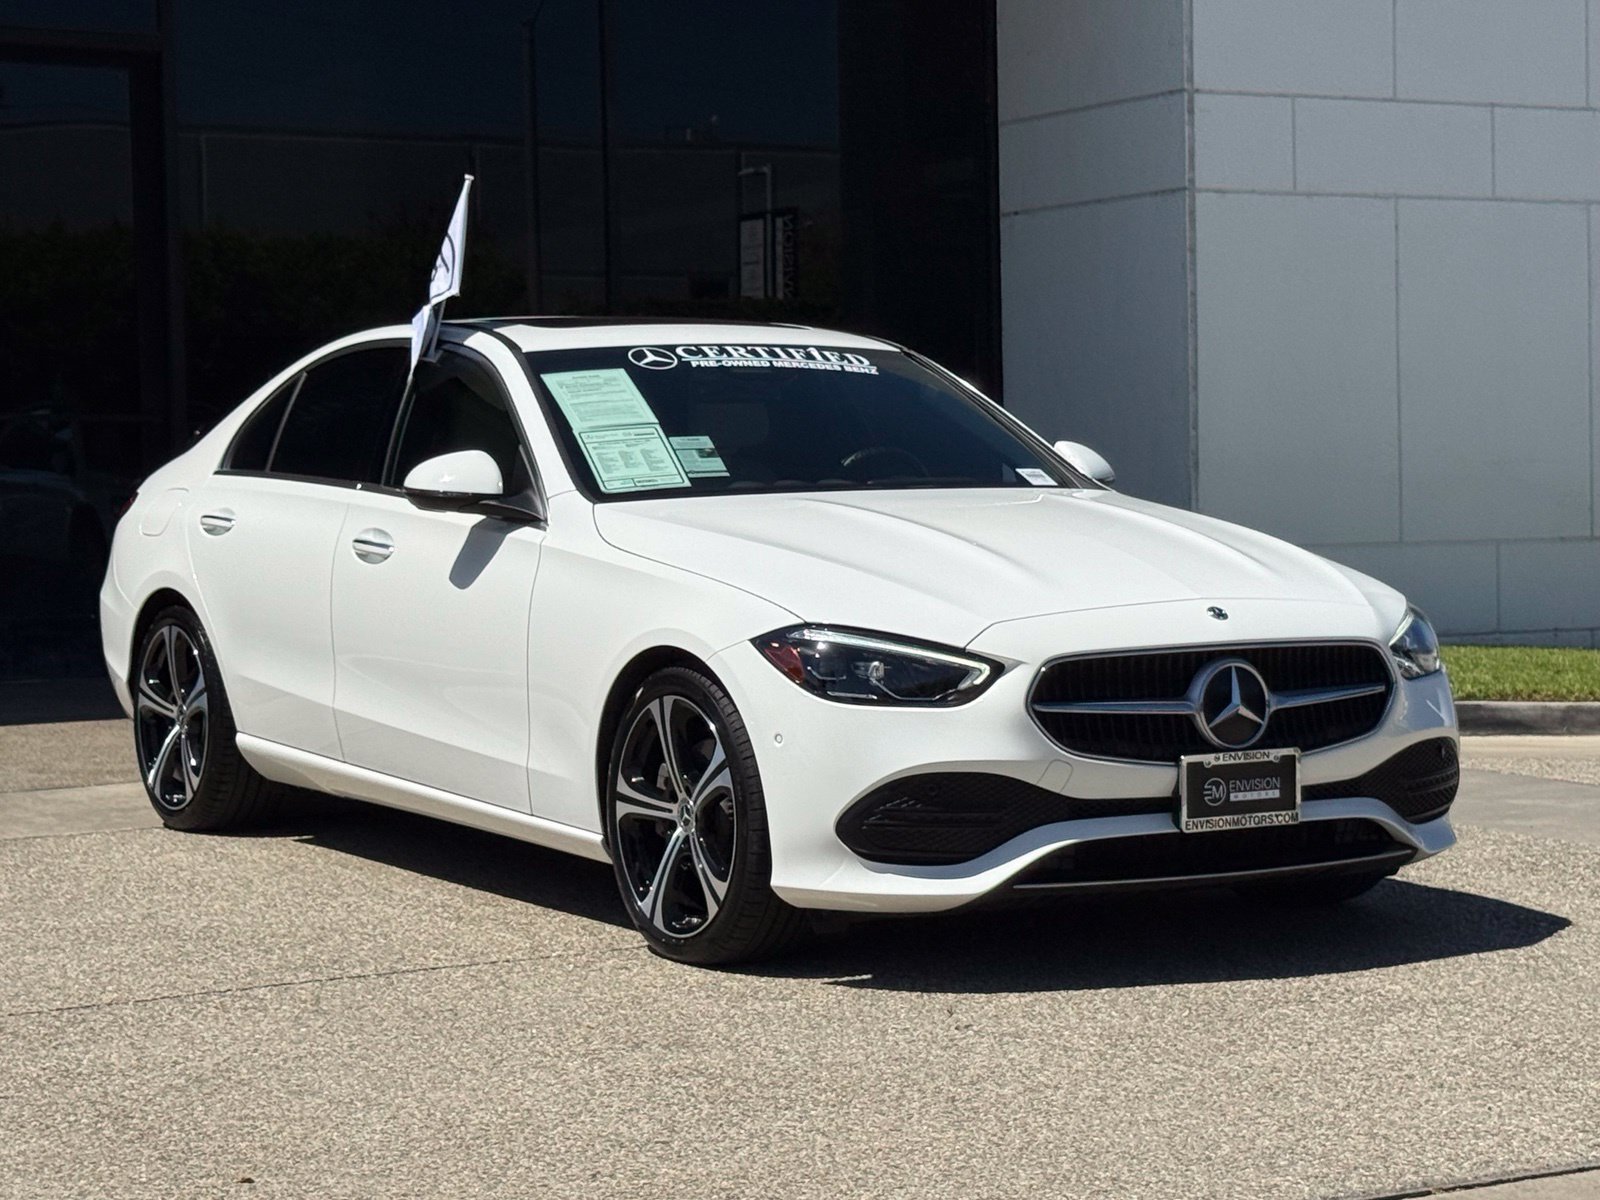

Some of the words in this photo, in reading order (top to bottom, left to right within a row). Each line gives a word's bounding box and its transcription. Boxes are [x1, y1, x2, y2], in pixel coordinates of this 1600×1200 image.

[690, 360, 770, 368] PRE-OWNED
[772, 360, 842, 371] MERCEDES
[843, 365, 880, 375] BENZ
[1222, 751, 1271, 762] ENVISION
[1229, 776, 1280, 791] ENVISION
[1185, 812, 1299, 830] ENVISIONMOTORS.COM
